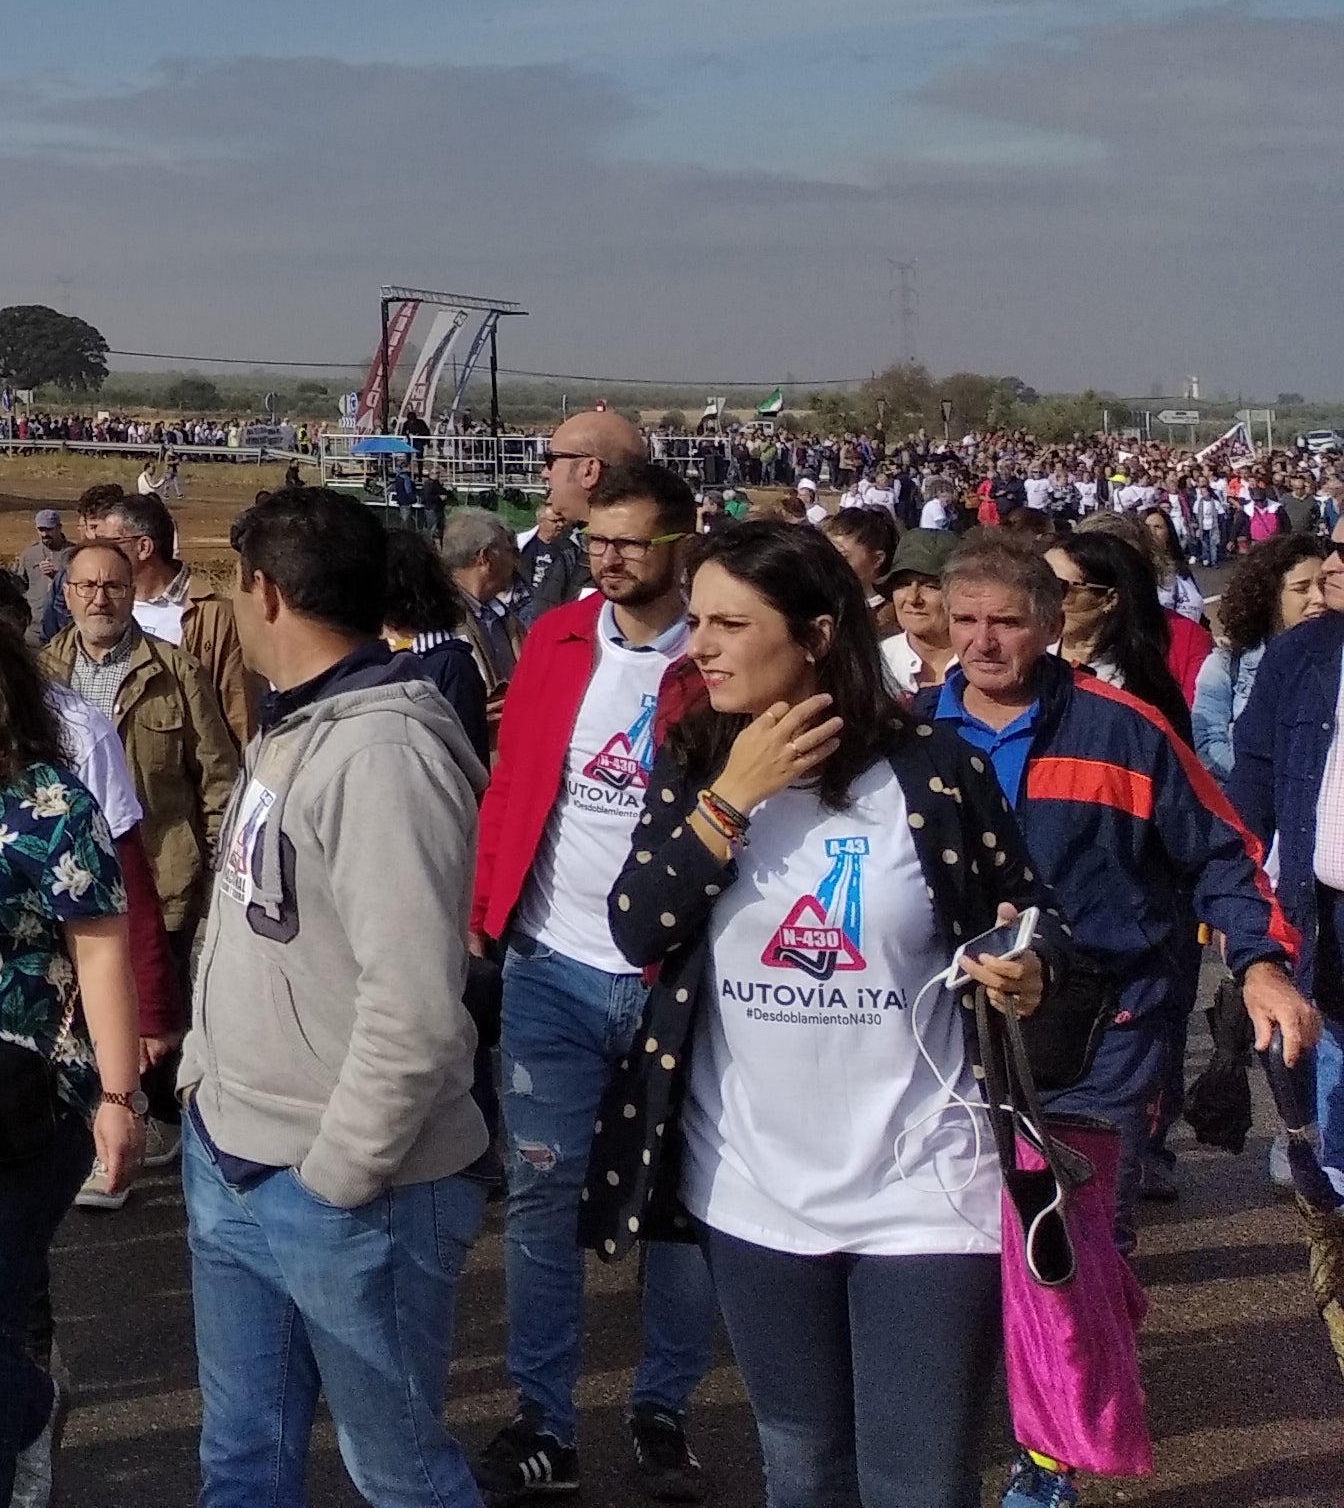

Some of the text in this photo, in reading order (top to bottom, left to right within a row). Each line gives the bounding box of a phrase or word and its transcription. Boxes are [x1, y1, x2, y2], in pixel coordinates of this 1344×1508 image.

[600, 755, 637, 774] N-430
[829, 839, 866, 855] A-43
[782, 928, 839, 948] N-430
[721, 978, 908, 1011] AUTOVÍA ¡YA!
[746, 1007, 882, 1026] #DesdoblamientoN430
